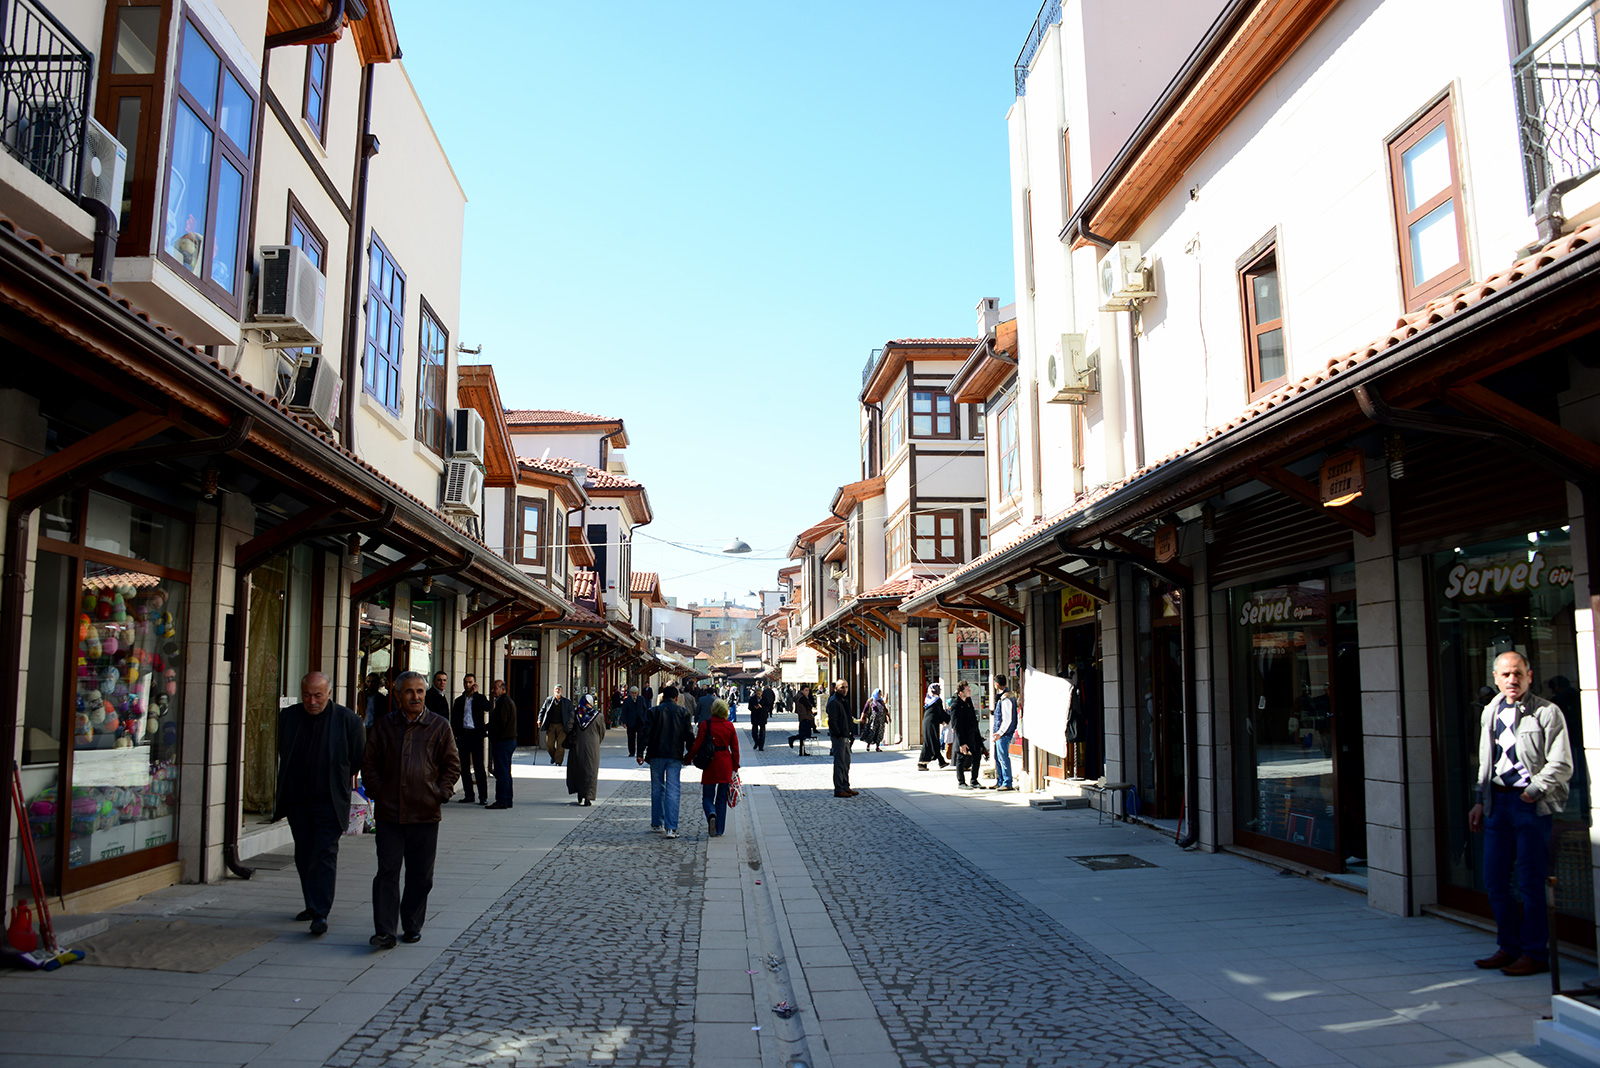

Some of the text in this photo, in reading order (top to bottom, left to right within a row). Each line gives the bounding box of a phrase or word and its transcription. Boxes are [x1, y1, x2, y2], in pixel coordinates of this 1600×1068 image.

[1444, 553, 1545, 599] Servet
[1240, 595, 1313, 626] Servet Giyim
